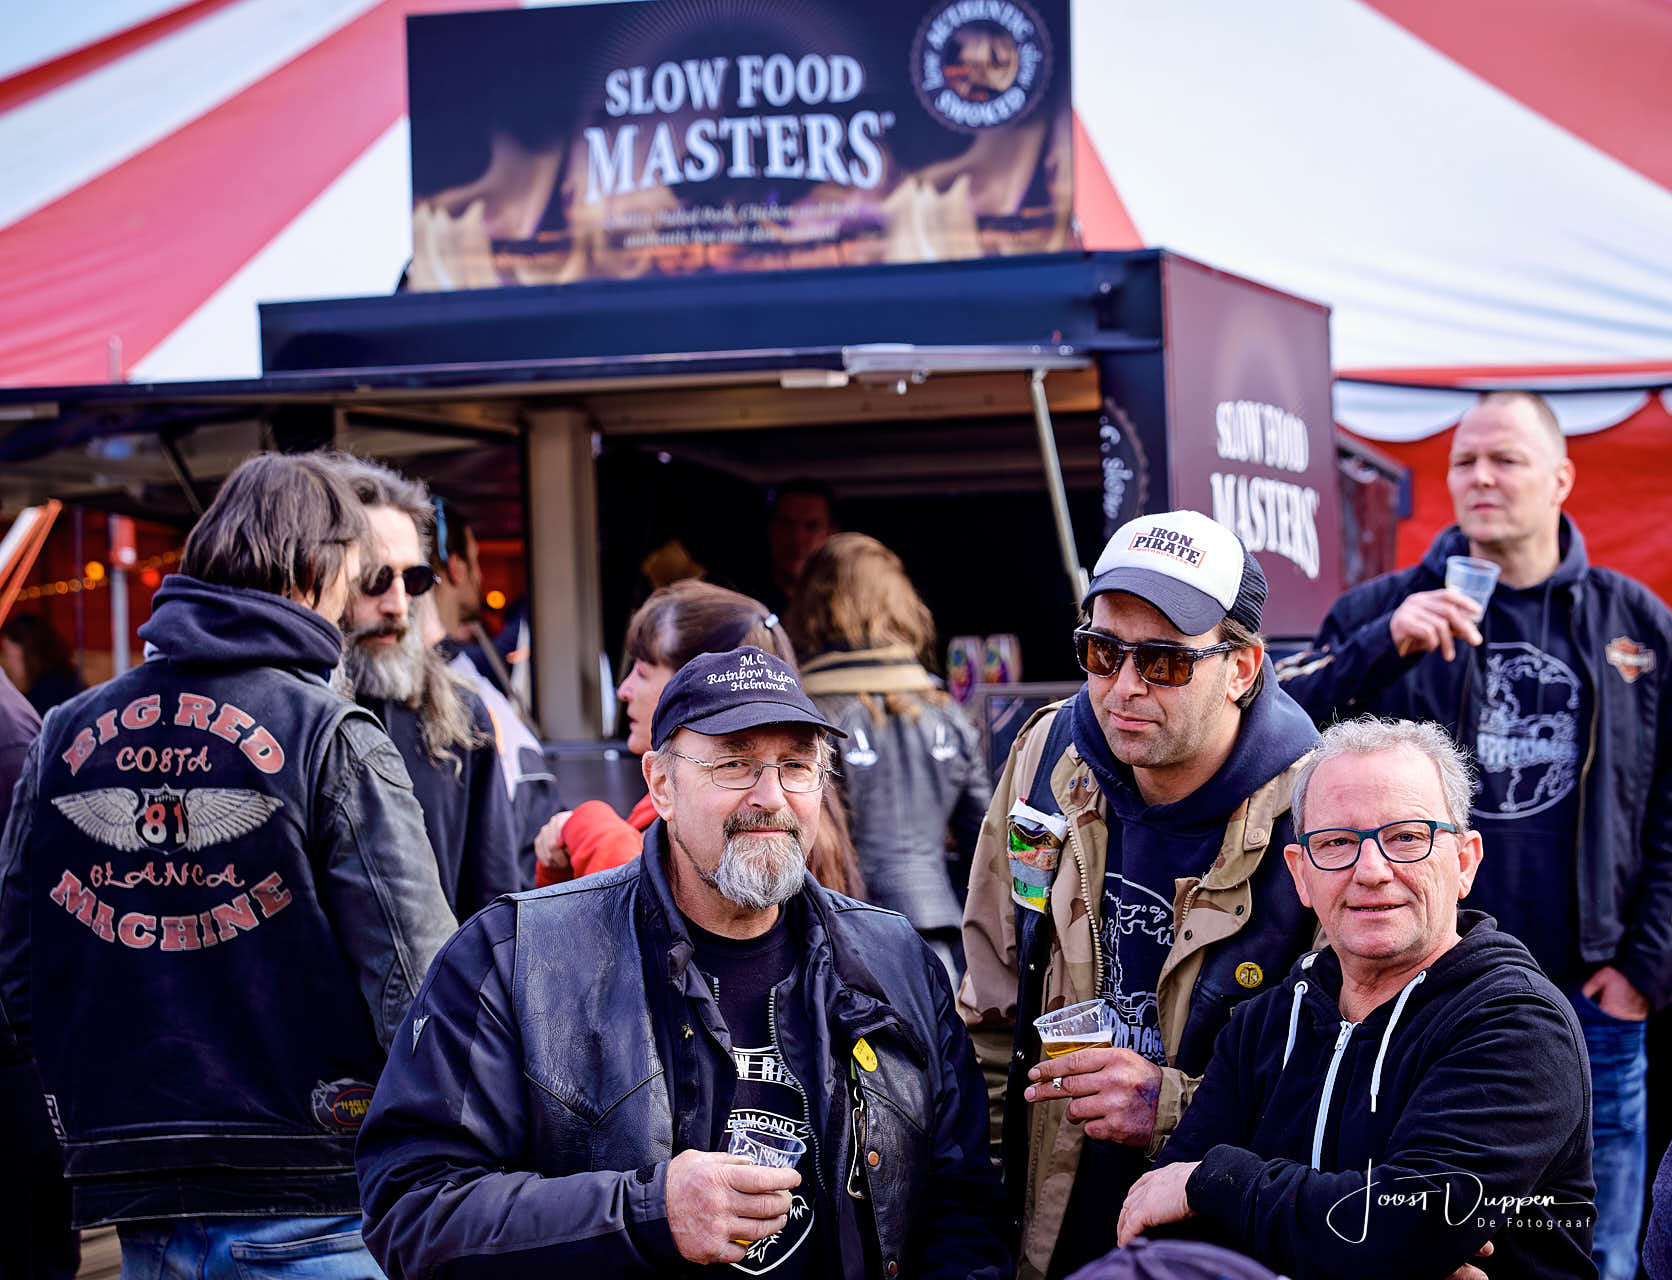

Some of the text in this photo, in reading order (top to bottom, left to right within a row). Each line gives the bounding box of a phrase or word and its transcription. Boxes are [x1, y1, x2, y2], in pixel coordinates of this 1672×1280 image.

[605, 53, 864, 117] SLOW FOOD
[935, 86, 1026, 127] SMOKED
[1216, 400, 1309, 473] SLOW FOOD
[1133, 536, 1200, 565] PIRATE
[1149, 526, 1194, 547] IRON
[707, 667, 763, 685] Rainbow
[731, 679, 788, 692] Helmond
[61, 692, 285, 776] BIG RED
[116, 746, 212, 776] COSTA
[142, 803, 187, 844] 81
[89, 862, 245, 888] BLANCA
[49, 869, 292, 951] MACHINE
